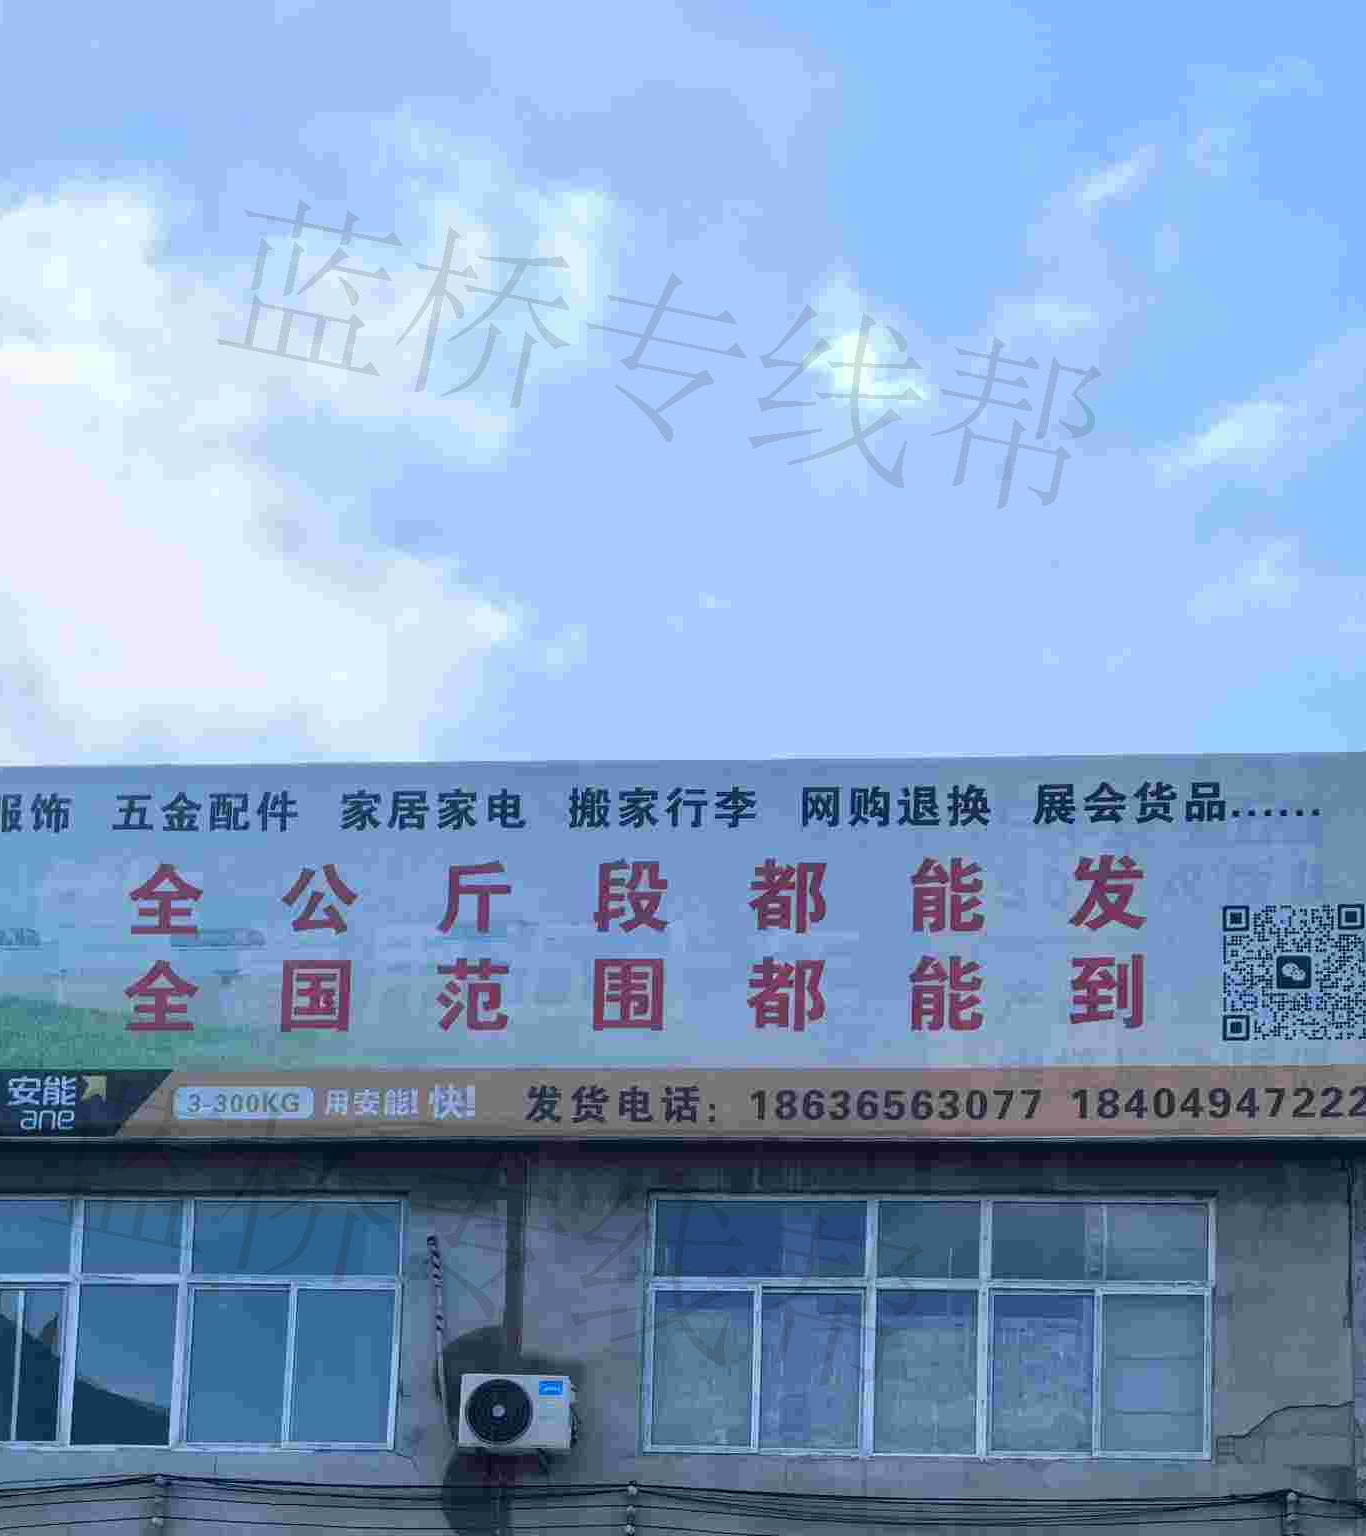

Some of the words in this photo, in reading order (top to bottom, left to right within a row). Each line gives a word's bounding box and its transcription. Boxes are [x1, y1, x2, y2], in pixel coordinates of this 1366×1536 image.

[111, 790, 299, 833] 五金配件
[339, 788, 527, 831] 家居家电
[568, 785, 759, 829] 搬家行李
[800, 784, 993, 828] 网购退换
[128, 854, 1146, 937] 全公斤段都能发
[124, 953, 1146, 1034] 全国范围都能到
[7, 1077, 76, 1107] 安能
[187, 1092, 300, 1115] 3-300KG
[749, 1089, 1042, 1122] 18636563077
[21, 1108, 76, 1130] ane
